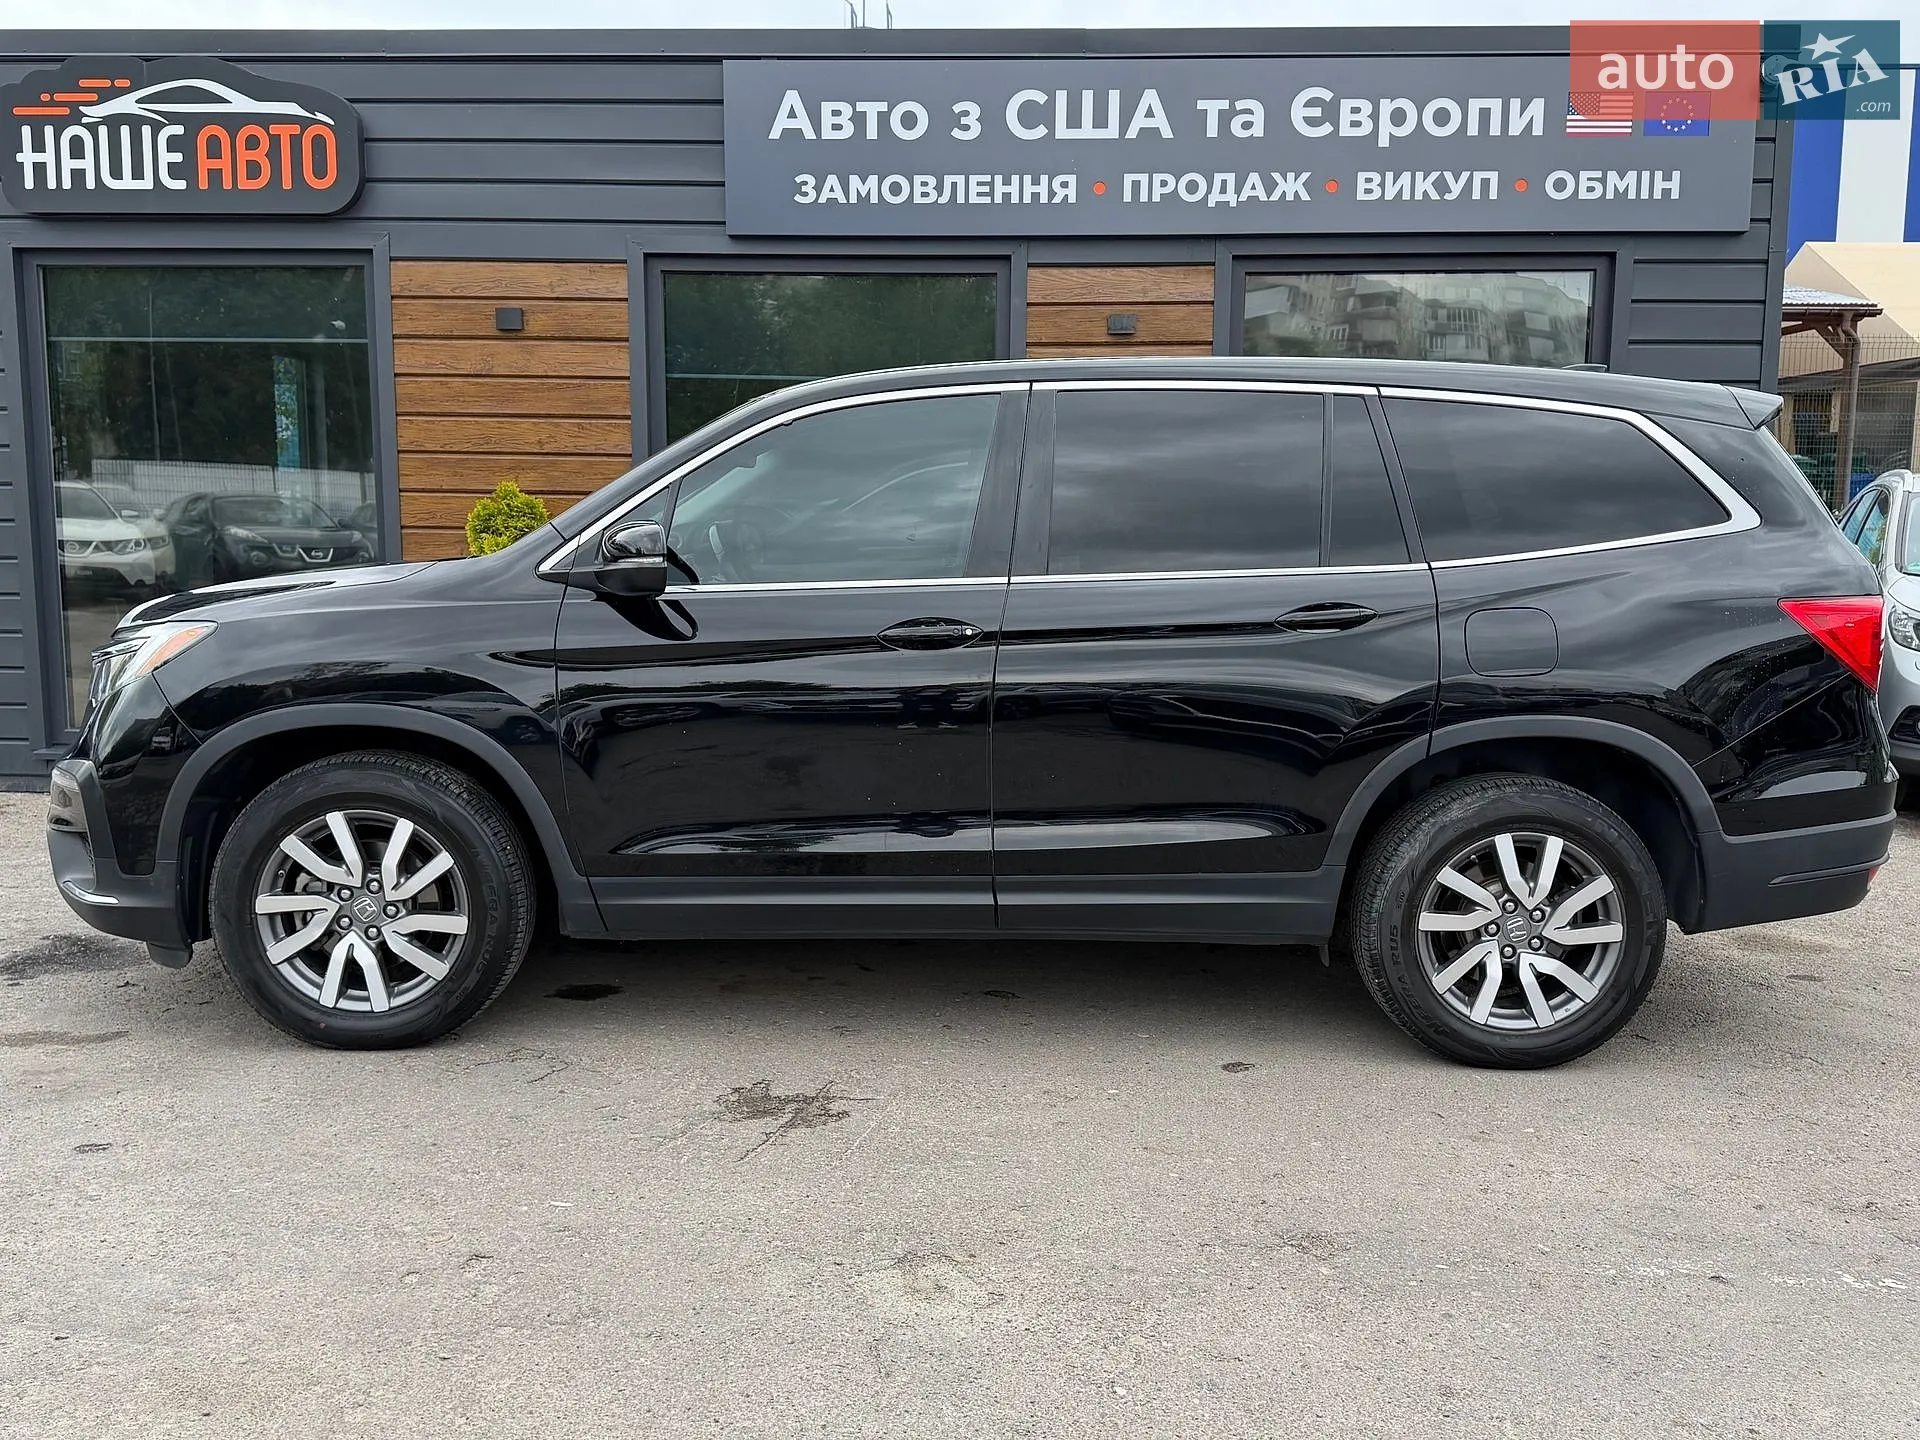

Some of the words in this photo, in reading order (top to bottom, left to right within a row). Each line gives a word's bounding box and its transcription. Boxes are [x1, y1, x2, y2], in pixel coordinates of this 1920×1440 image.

[768, 89, 929, 141] Авто
[950, 101, 982, 141] з
[1005, 88, 1174, 141] США
[1196, 98, 1265, 138] та
[1290, 86, 1546, 148] Європи
[16, 125, 187, 190] НАШЕ
[197, 124, 338, 190] АВТО
[793, 173, 1078, 205] ЗАМОВЛЕННЯ
[1122, 171, 1312, 208] ПРОДАЖ
[1356, 171, 1499, 201] ВИКУП
[1544, 170, 1682, 200] ОБМІН
